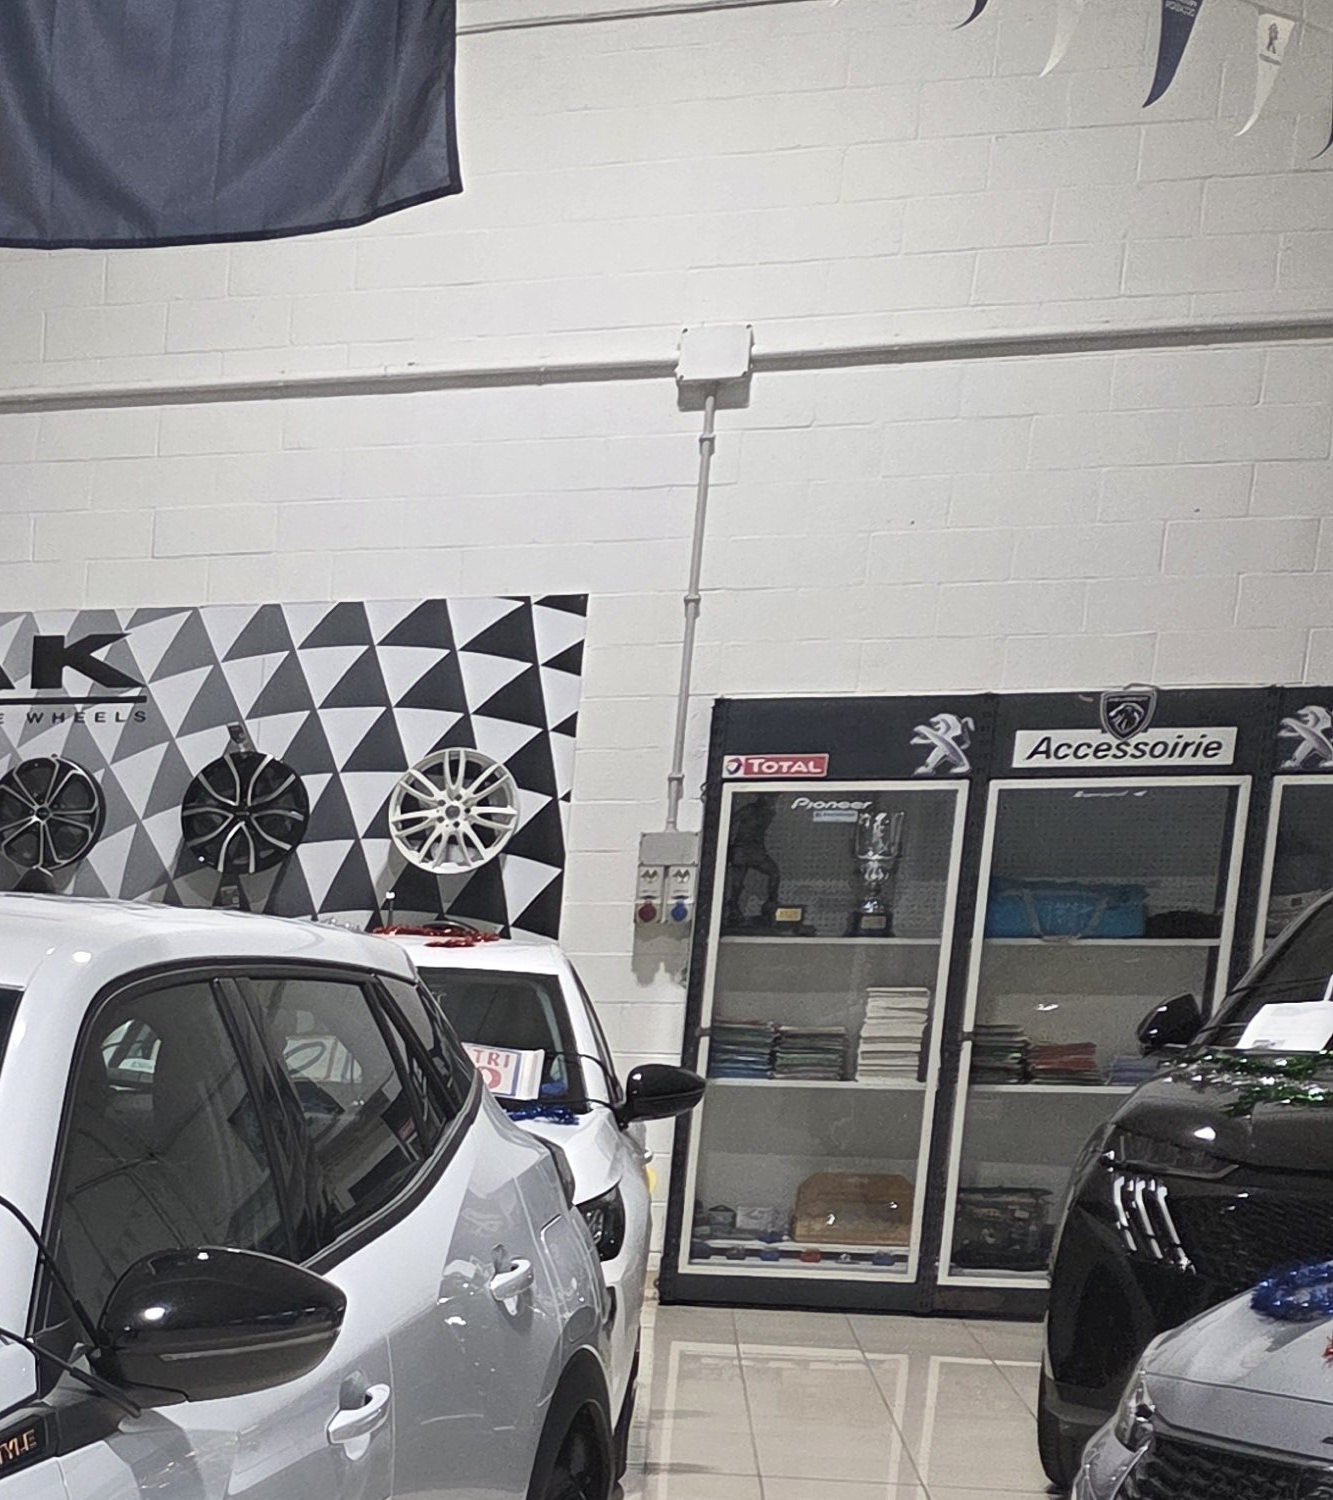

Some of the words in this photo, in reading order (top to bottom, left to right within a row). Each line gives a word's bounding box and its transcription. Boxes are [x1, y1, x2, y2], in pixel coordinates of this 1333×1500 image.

[26, 709, 148, 725] WHEELS
[1025, 734, 1224, 763] Accessoirie
[748, 757, 822, 775] TOTAL
[790, 796, 874, 810] Pioneer
